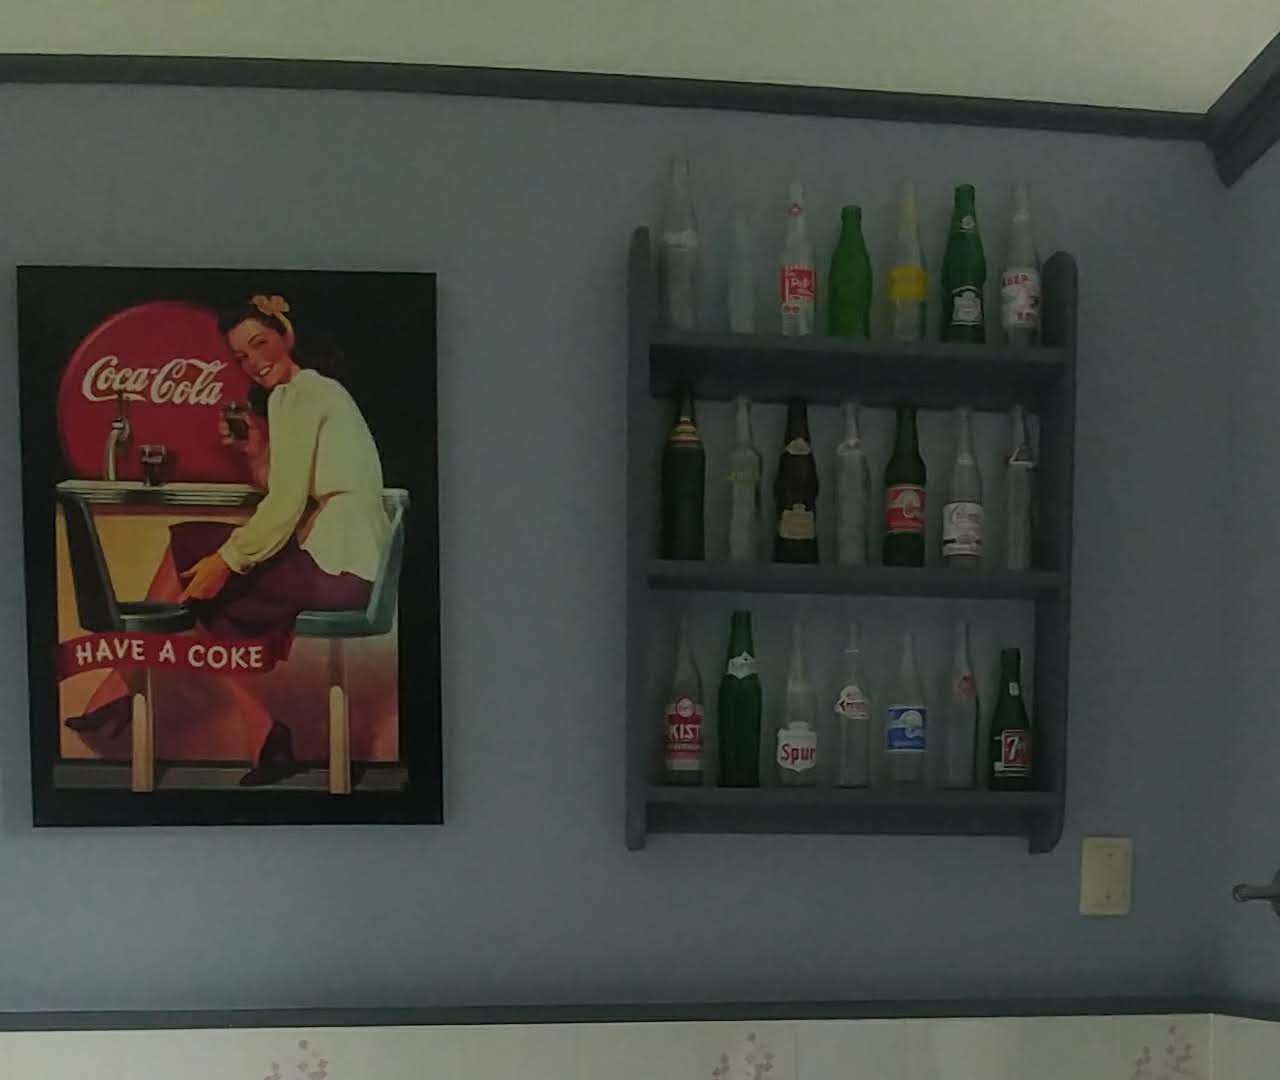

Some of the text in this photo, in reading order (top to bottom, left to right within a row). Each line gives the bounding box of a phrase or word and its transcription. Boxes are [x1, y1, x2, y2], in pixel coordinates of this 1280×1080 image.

[81, 355, 228, 406] Coca-Cola
[75, 637, 264, 670] HAVE A COKE
[670, 724, 701, 740] KIST
[780, 743, 816, 765] Spur
